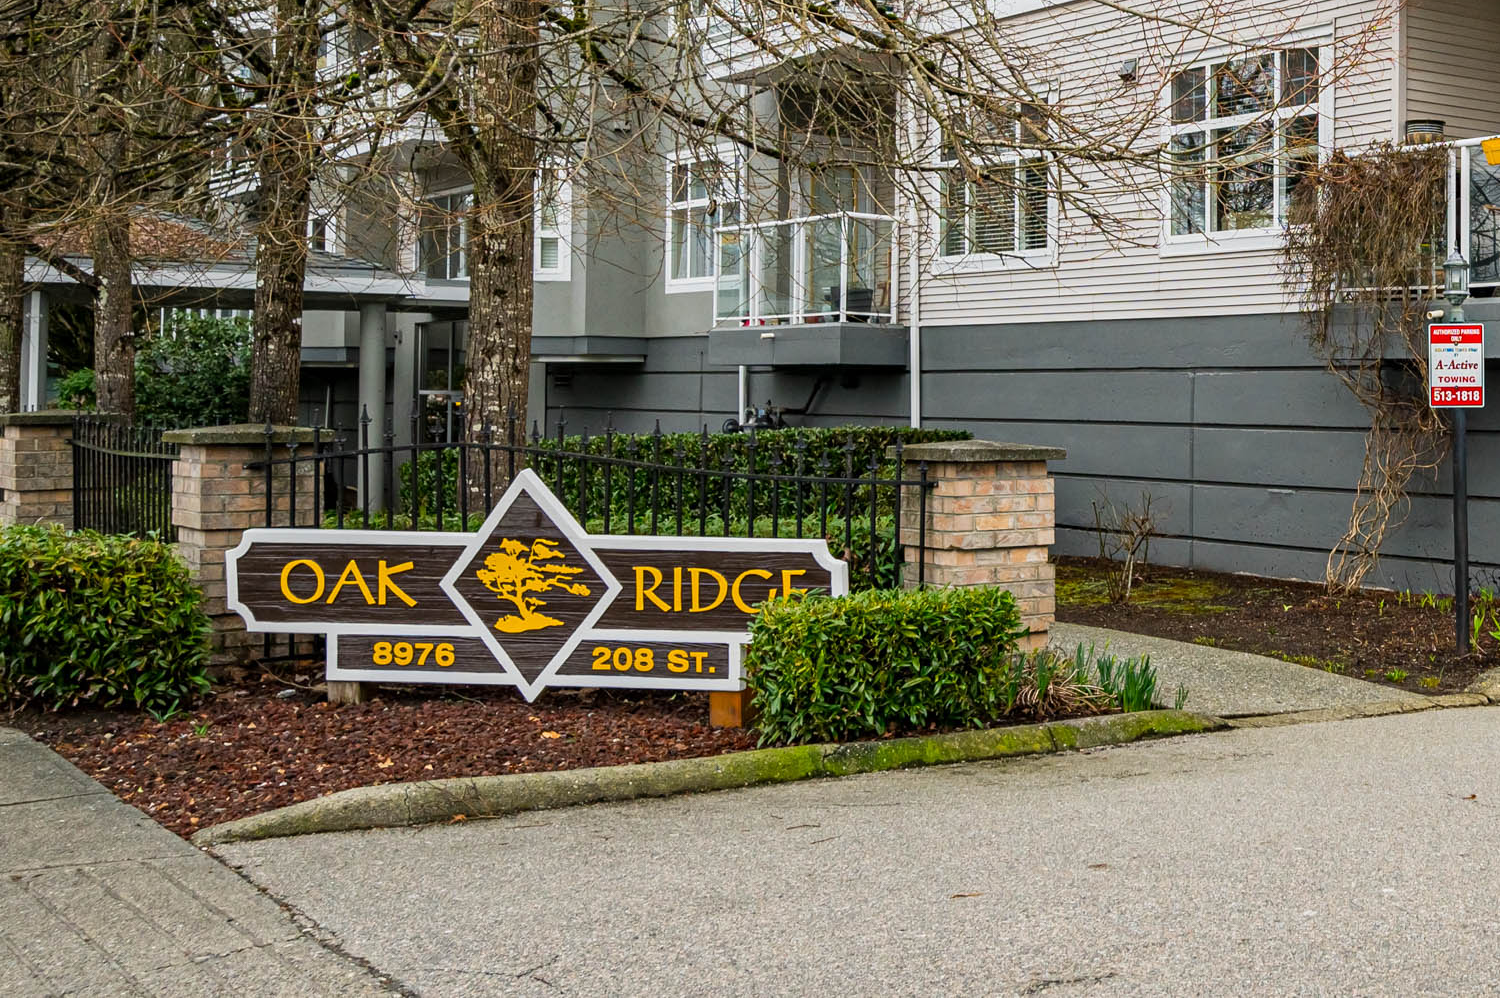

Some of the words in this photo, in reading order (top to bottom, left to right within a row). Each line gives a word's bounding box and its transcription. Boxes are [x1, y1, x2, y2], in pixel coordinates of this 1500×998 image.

[1435, 359, 1478, 370] A-Active
[1434, 391, 1480, 401] 513-1818
[280, 559, 418, 607] OAK
[632, 566, 808, 614] RIDGE
[372, 641, 455, 667] 8976
[592, 647, 655, 672] 208
[667, 649, 716, 673] ST.
